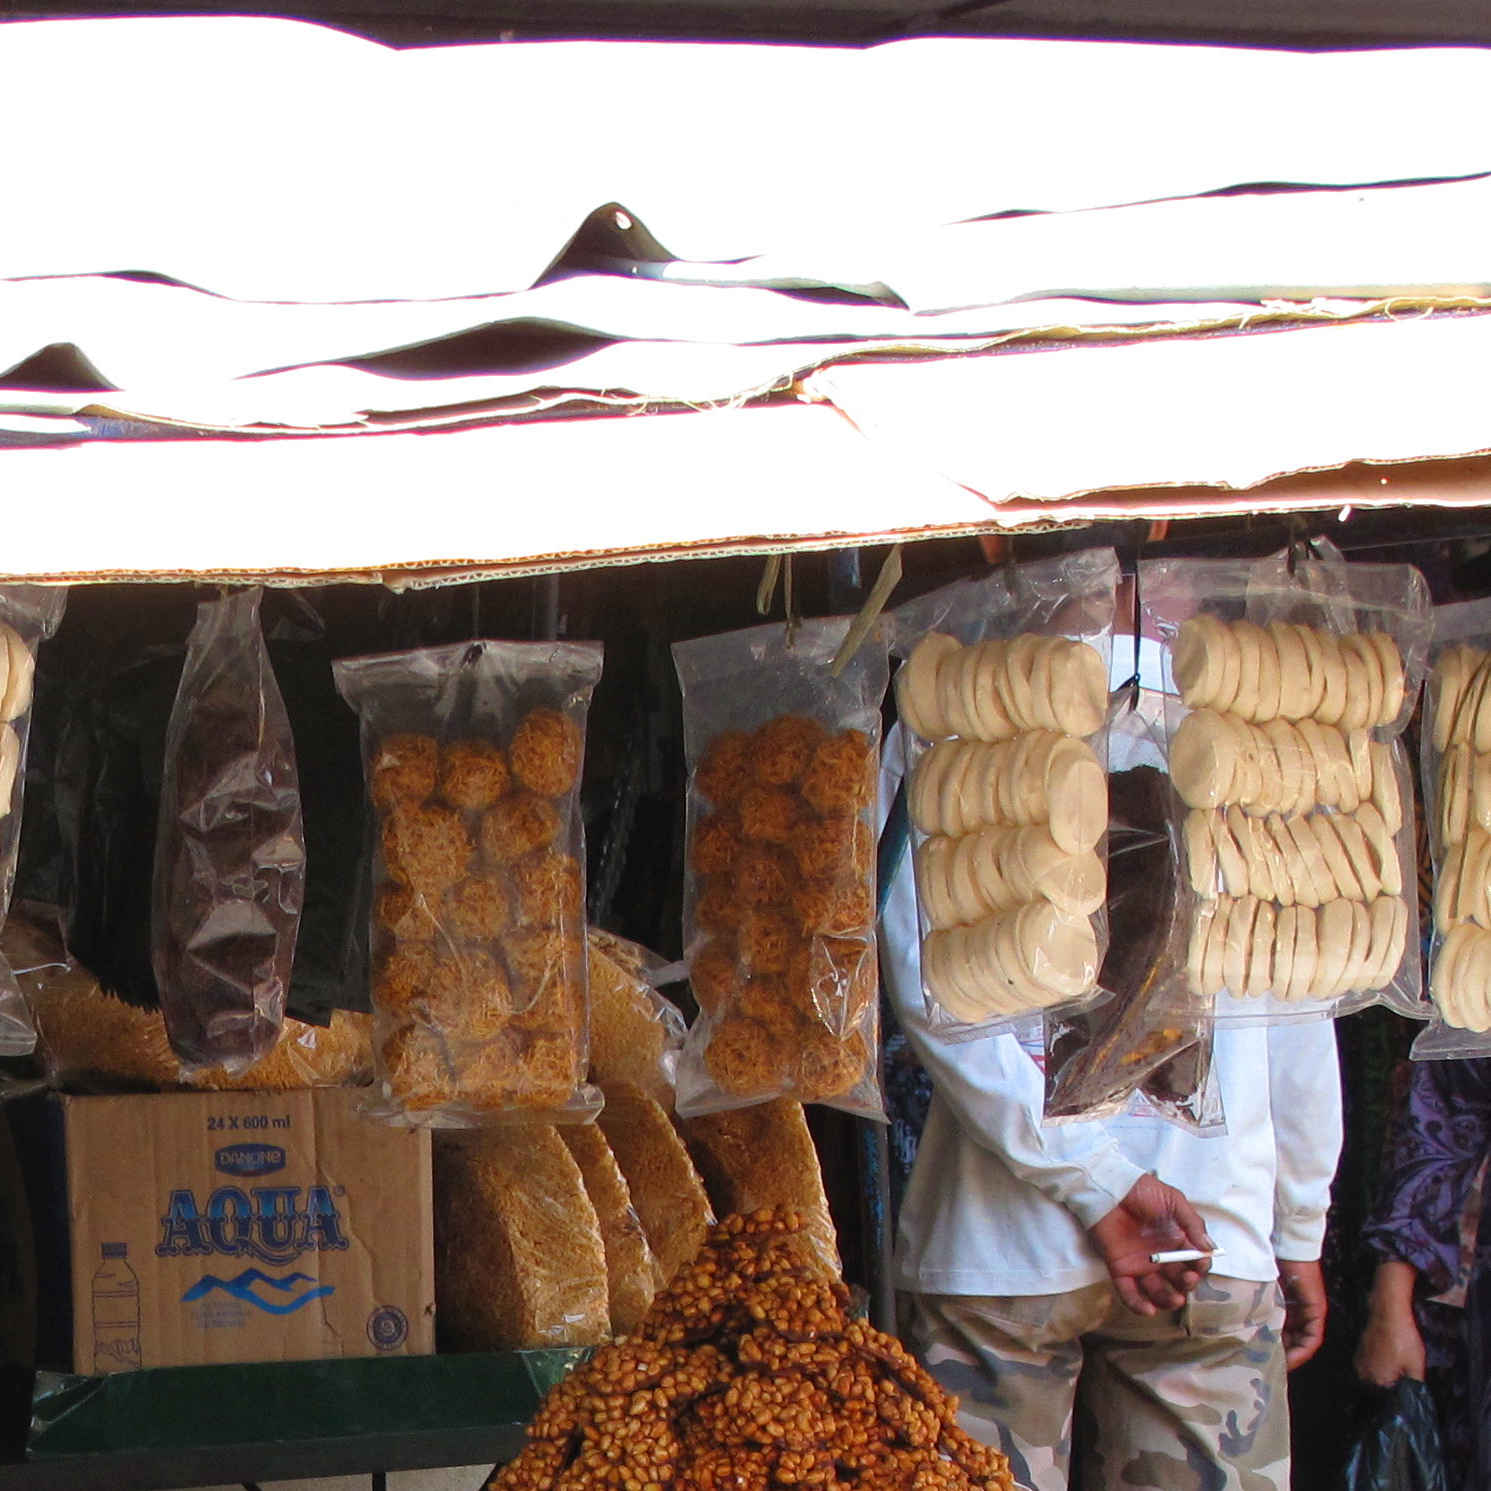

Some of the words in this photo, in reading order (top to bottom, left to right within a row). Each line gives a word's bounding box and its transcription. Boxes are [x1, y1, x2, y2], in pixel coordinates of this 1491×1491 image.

[207, 1117, 225, 1130] 24
[229, 1116, 239, 1129] X
[243, 1116, 268, 1129] 600
[272, 1115, 291, 1129] ml
[155, 1185, 350, 1267] AQUA
